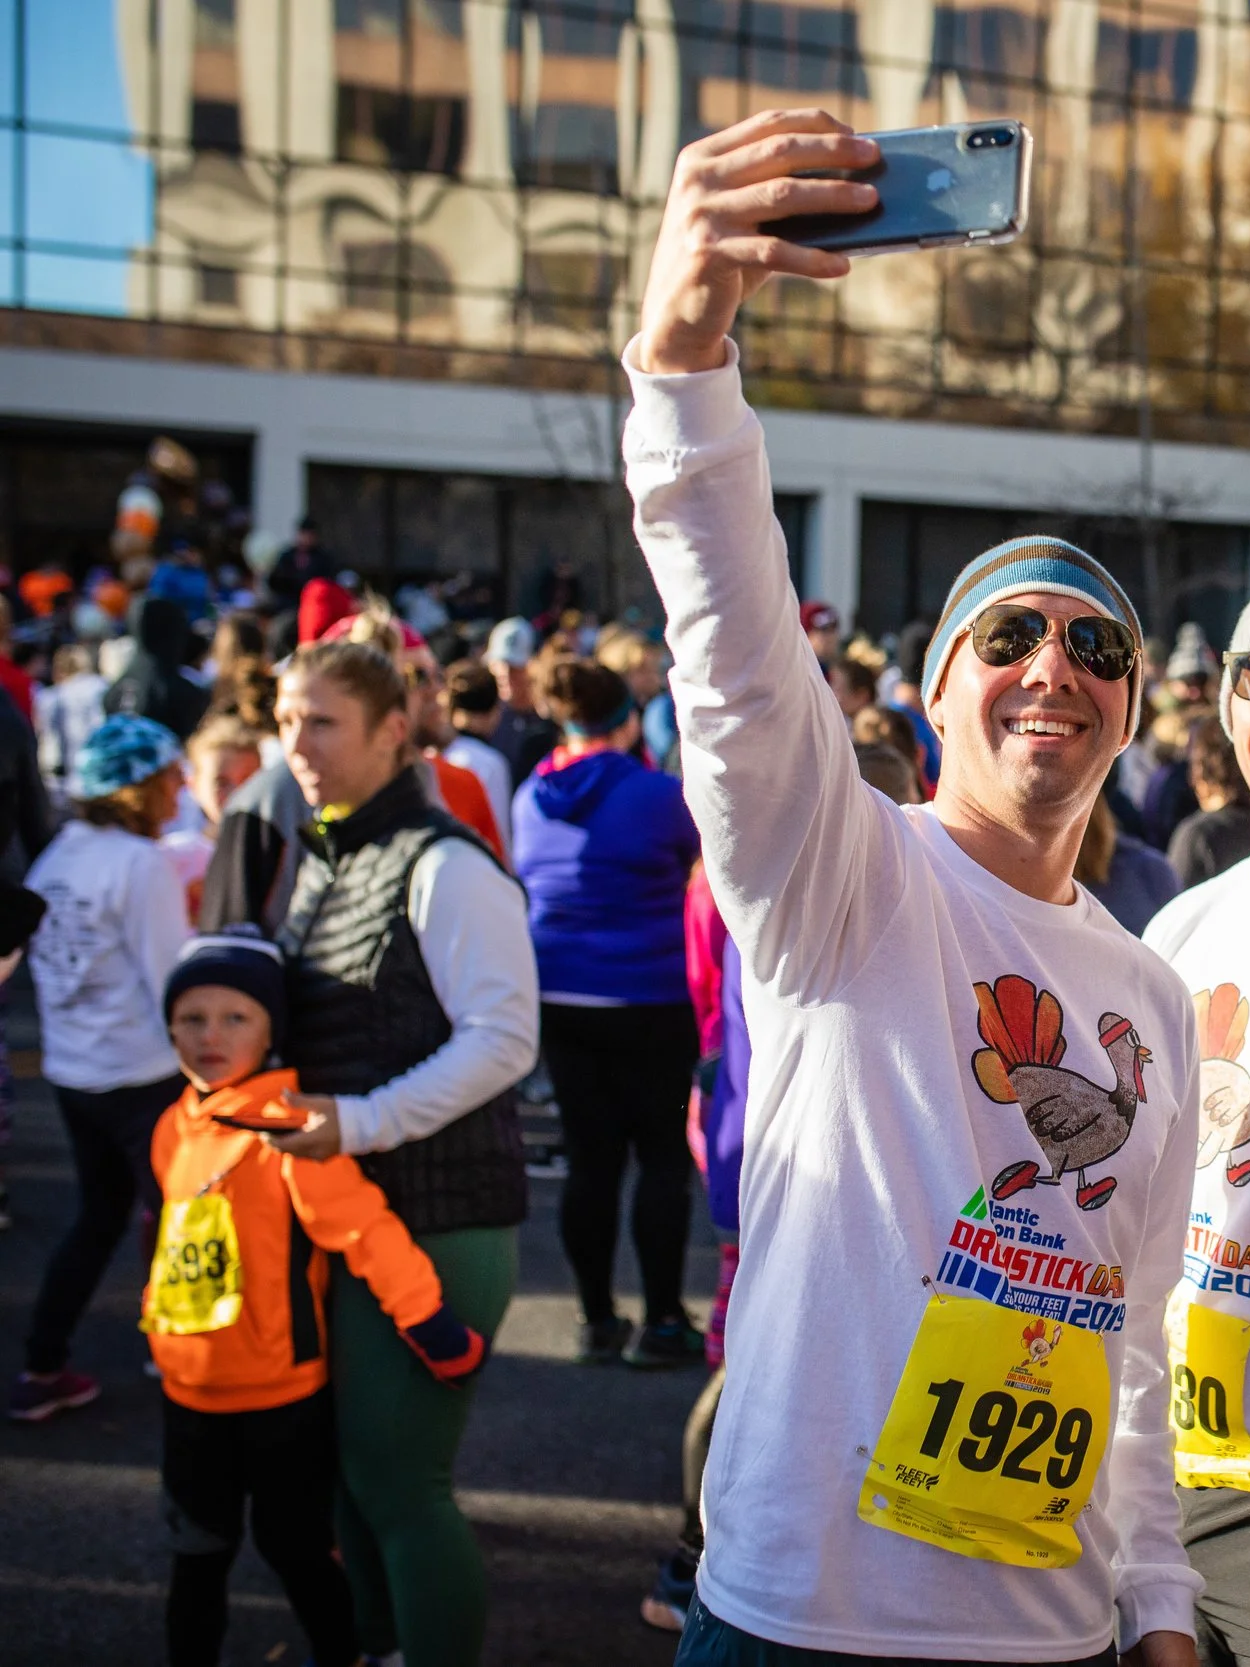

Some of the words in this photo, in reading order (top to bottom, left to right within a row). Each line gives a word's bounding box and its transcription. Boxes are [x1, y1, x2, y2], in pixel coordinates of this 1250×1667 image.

[1018, 1225, 1067, 1250] Bank
[1013, 1291, 1040, 1307] YOUR
[1041, 1296, 1066, 1311] FEET
[1067, 1298, 1126, 1332] 2019
[1032, 1385, 1052, 1396] 2019
[919, 1378, 1093, 1490] 1929
[895, 1463, 931, 1484] FLEET
[895, 1473, 924, 1489] FEET
